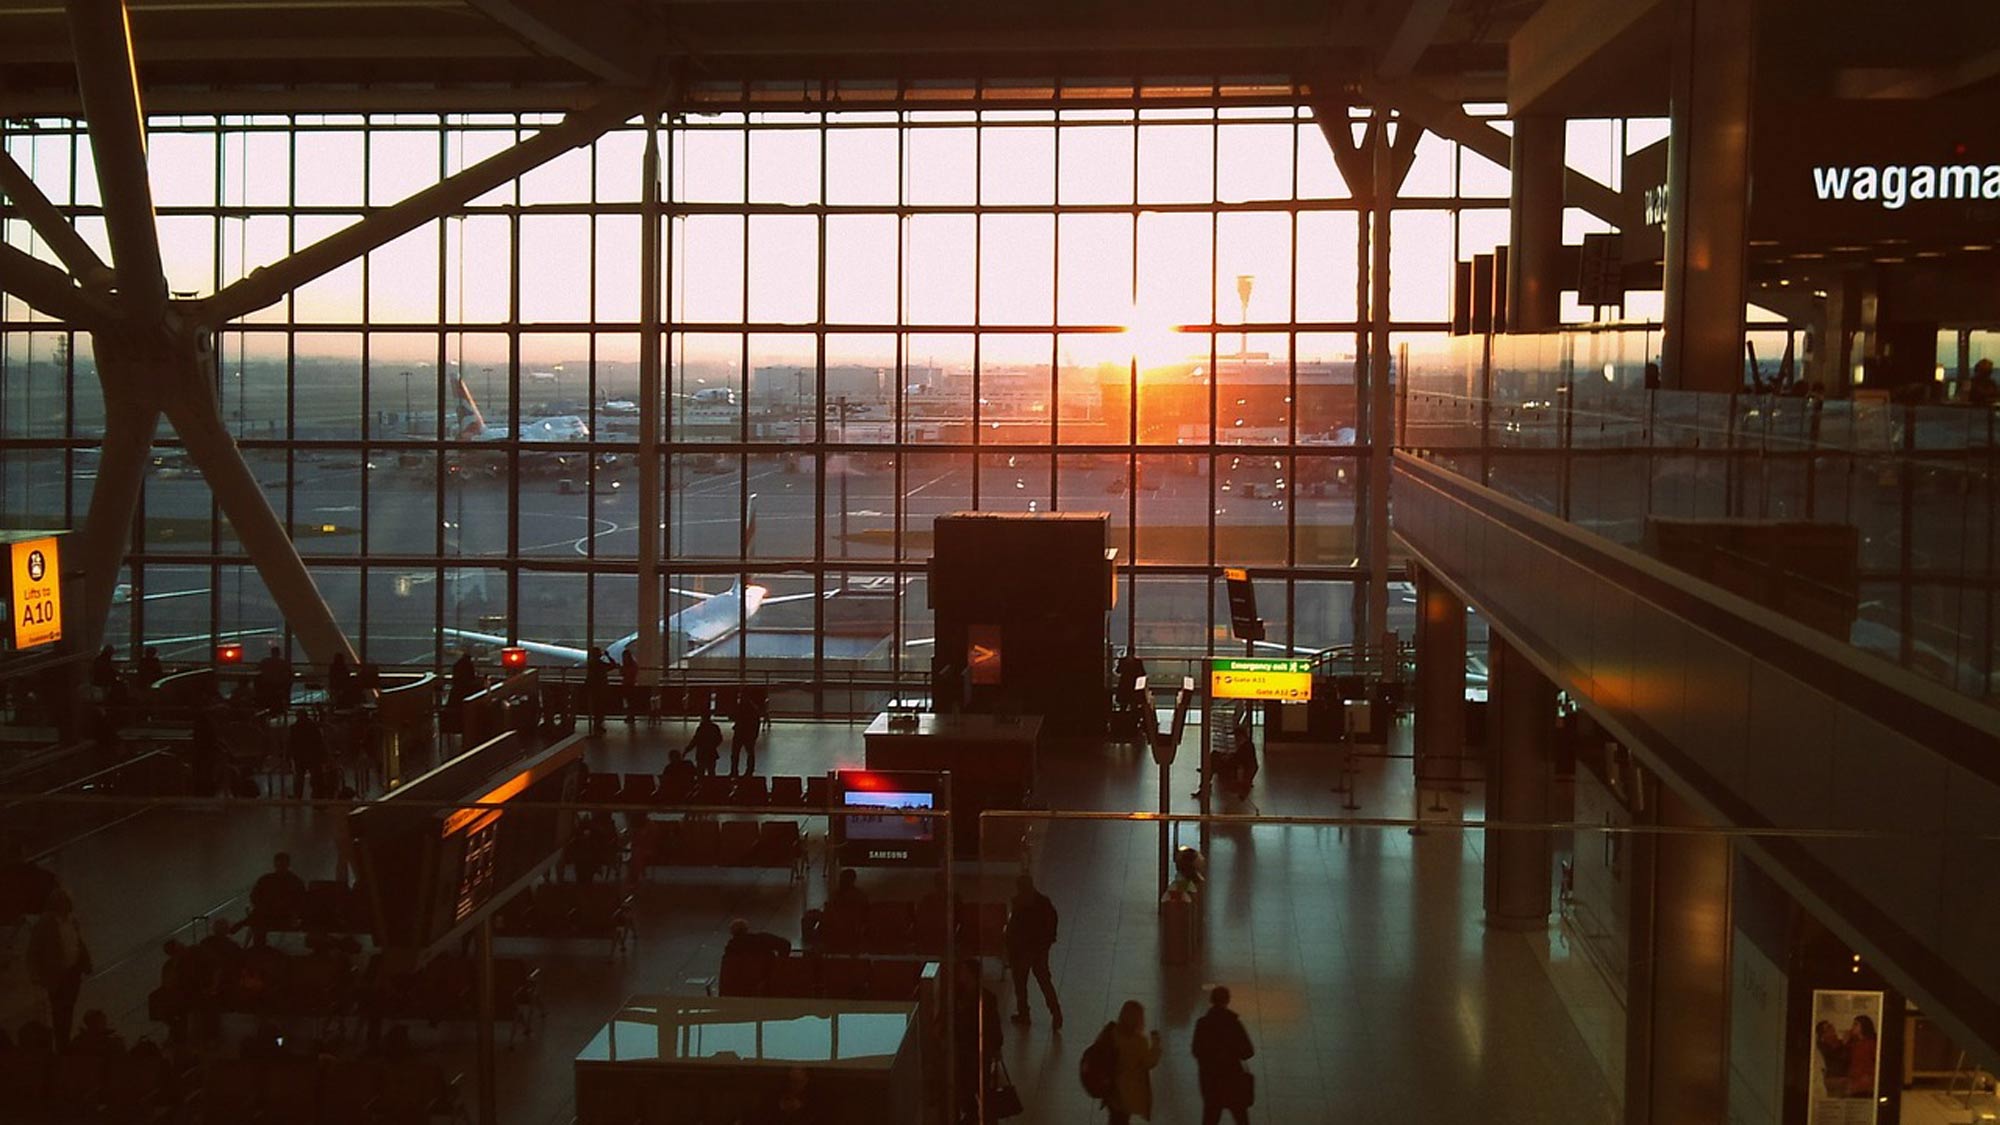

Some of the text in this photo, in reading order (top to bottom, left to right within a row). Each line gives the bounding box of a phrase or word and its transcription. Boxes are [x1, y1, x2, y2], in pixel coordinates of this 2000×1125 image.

[1813, 164, 2000, 209] wagama
[22, 600, 54, 627] A10
[1231, 662, 1288, 671] Emergency exit
[869, 851, 907, 859] SAMSUNG
